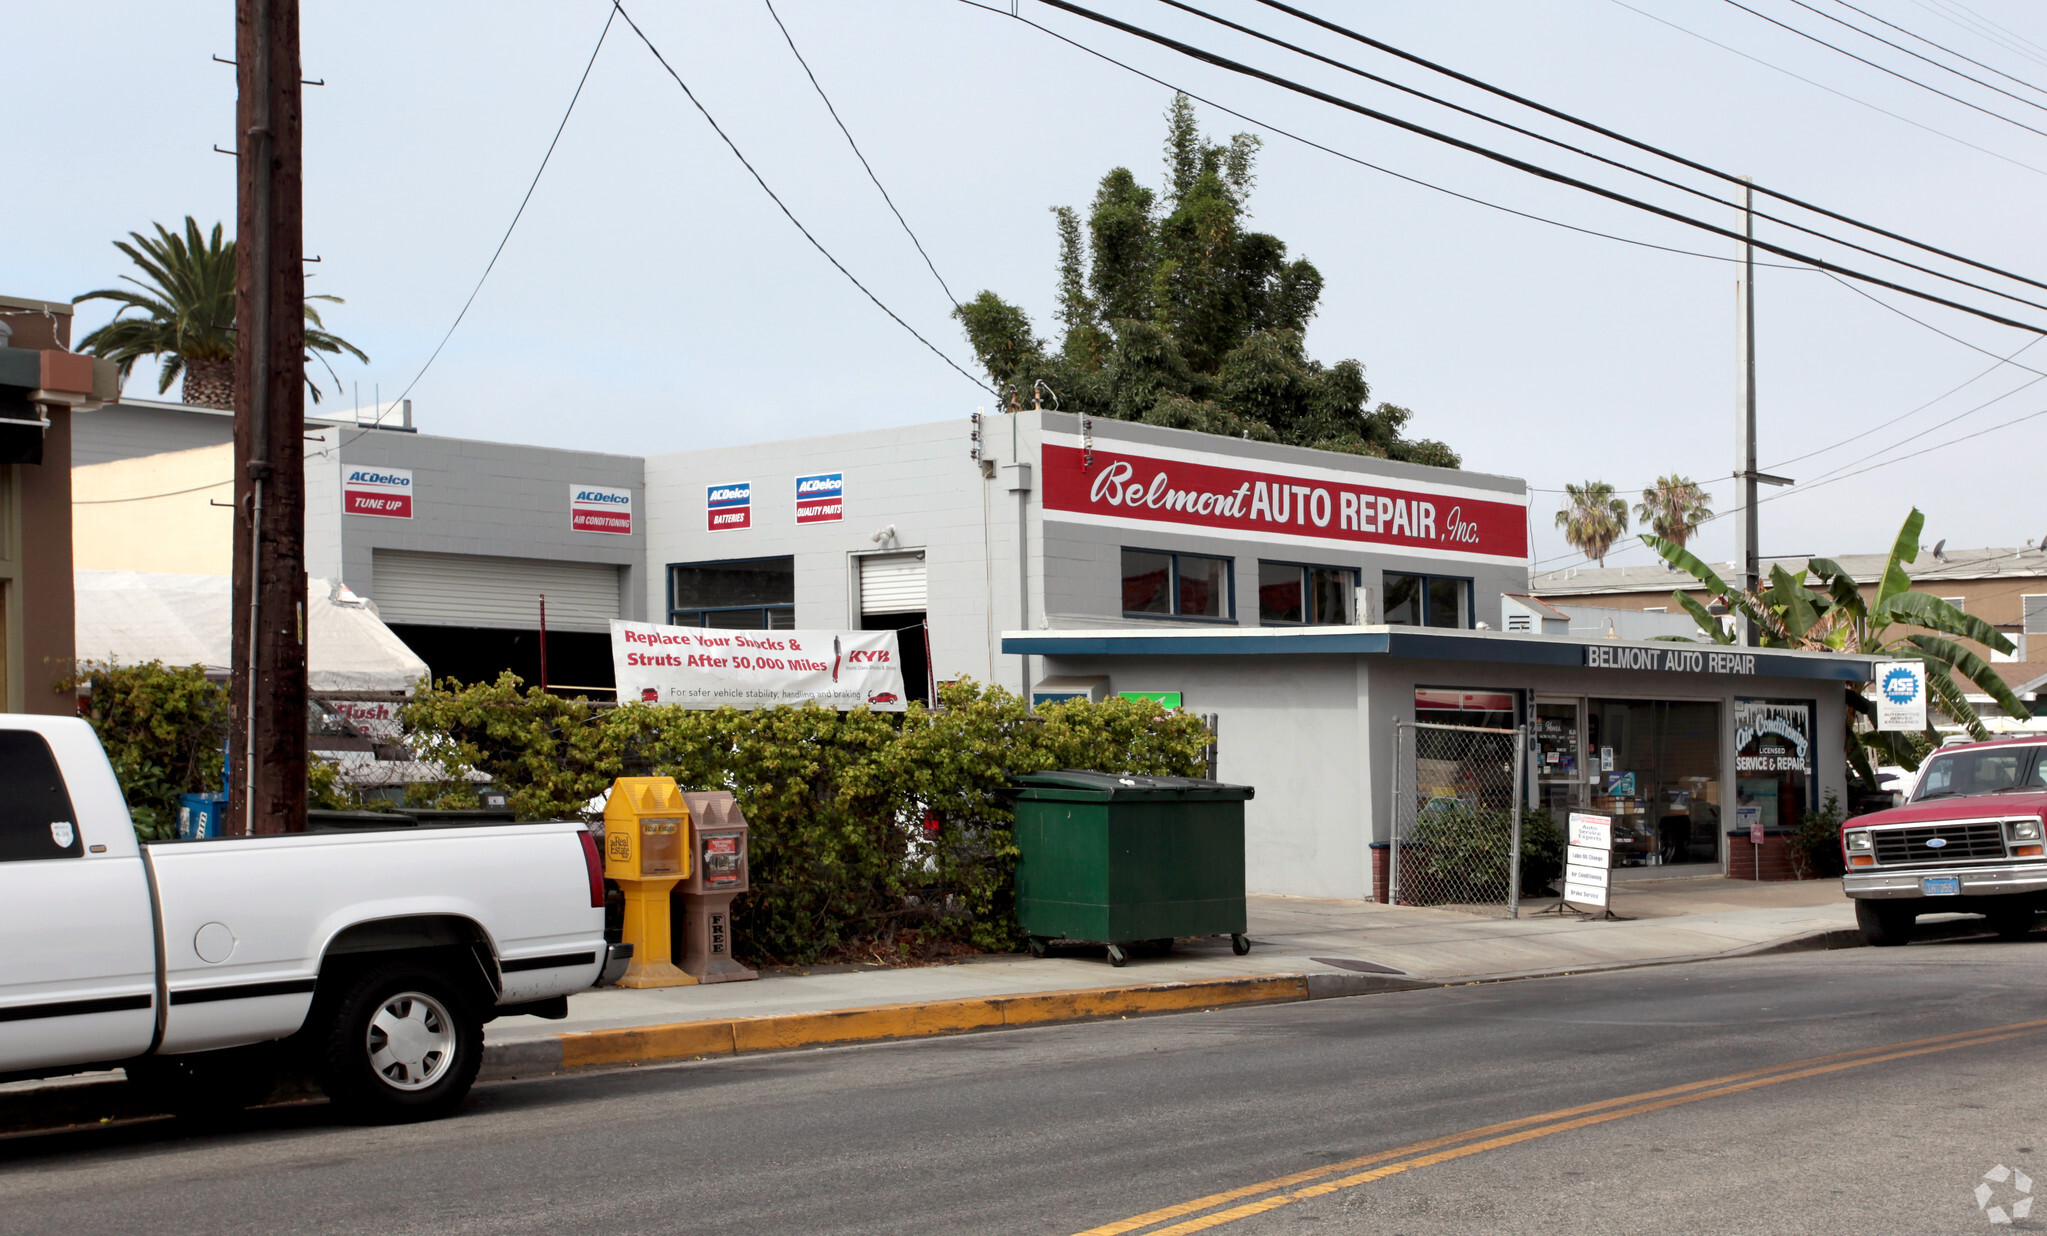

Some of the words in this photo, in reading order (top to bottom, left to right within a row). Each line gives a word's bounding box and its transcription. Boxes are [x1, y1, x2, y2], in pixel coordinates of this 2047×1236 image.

[349, 471, 410, 486] ACDelco
[799, 478, 842, 492] ACDelco
[576, 491, 629, 504] ACDelco
[710, 488, 750, 501] ACDelco
[1090, 460, 1250, 518] Belmont
[1250, 481, 1332, 528] AUTO
[1340, 491, 1436, 539] REPAIR
[355, 497, 385, 509] TUNE
[385, 501, 402, 510] UP
[797, 506, 822, 517] QUALITY
[822, 504, 842, 515] PARTS
[573, 515, 585, 524] AIR
[585, 516, 630, 528] CONDITIONING
[713, 513, 745, 524] BATTERIES
[625, 630, 690, 647] Replace
[694, 635, 730, 648] Your
[735, 636, 785, 651] Shocks
[789, 639, 801, 651] &
[627, 652, 682, 667] Struts
[687, 654, 728, 668] After
[732, 656, 784, 671] 50,000
[788, 659, 827, 672] Miles
[849, 650, 890, 662] KYB
[1588, 646, 1661, 670] BELMONT
[1664, 651, 1703, 673] AUTO
[1708, 653, 1756, 675] REPAIR
[1886, 678, 1914, 692] ASE
[670, 687, 685, 697] For
[689, 687, 711, 697] safer
[714, 687, 744, 698] vehicle
[745, 688, 780, 700] stability,
[782, 689, 815, 700] handling
[817, 689, 832, 699] and
[833, 689, 861, 700] braking
[1528, 688, 1536, 752] 3720
[1755, 713, 1808, 758] Conditioning
[1759, 747, 1785, 755] LICENSED
[1736, 756, 1768, 771] SERVICE
[1769, 758, 1776, 771] &
[1776, 757, 1805, 771] REPAIR
[615, 836, 629, 847] Real
[610, 844, 629, 855] Estate
[712, 915, 724, 953] FREE
